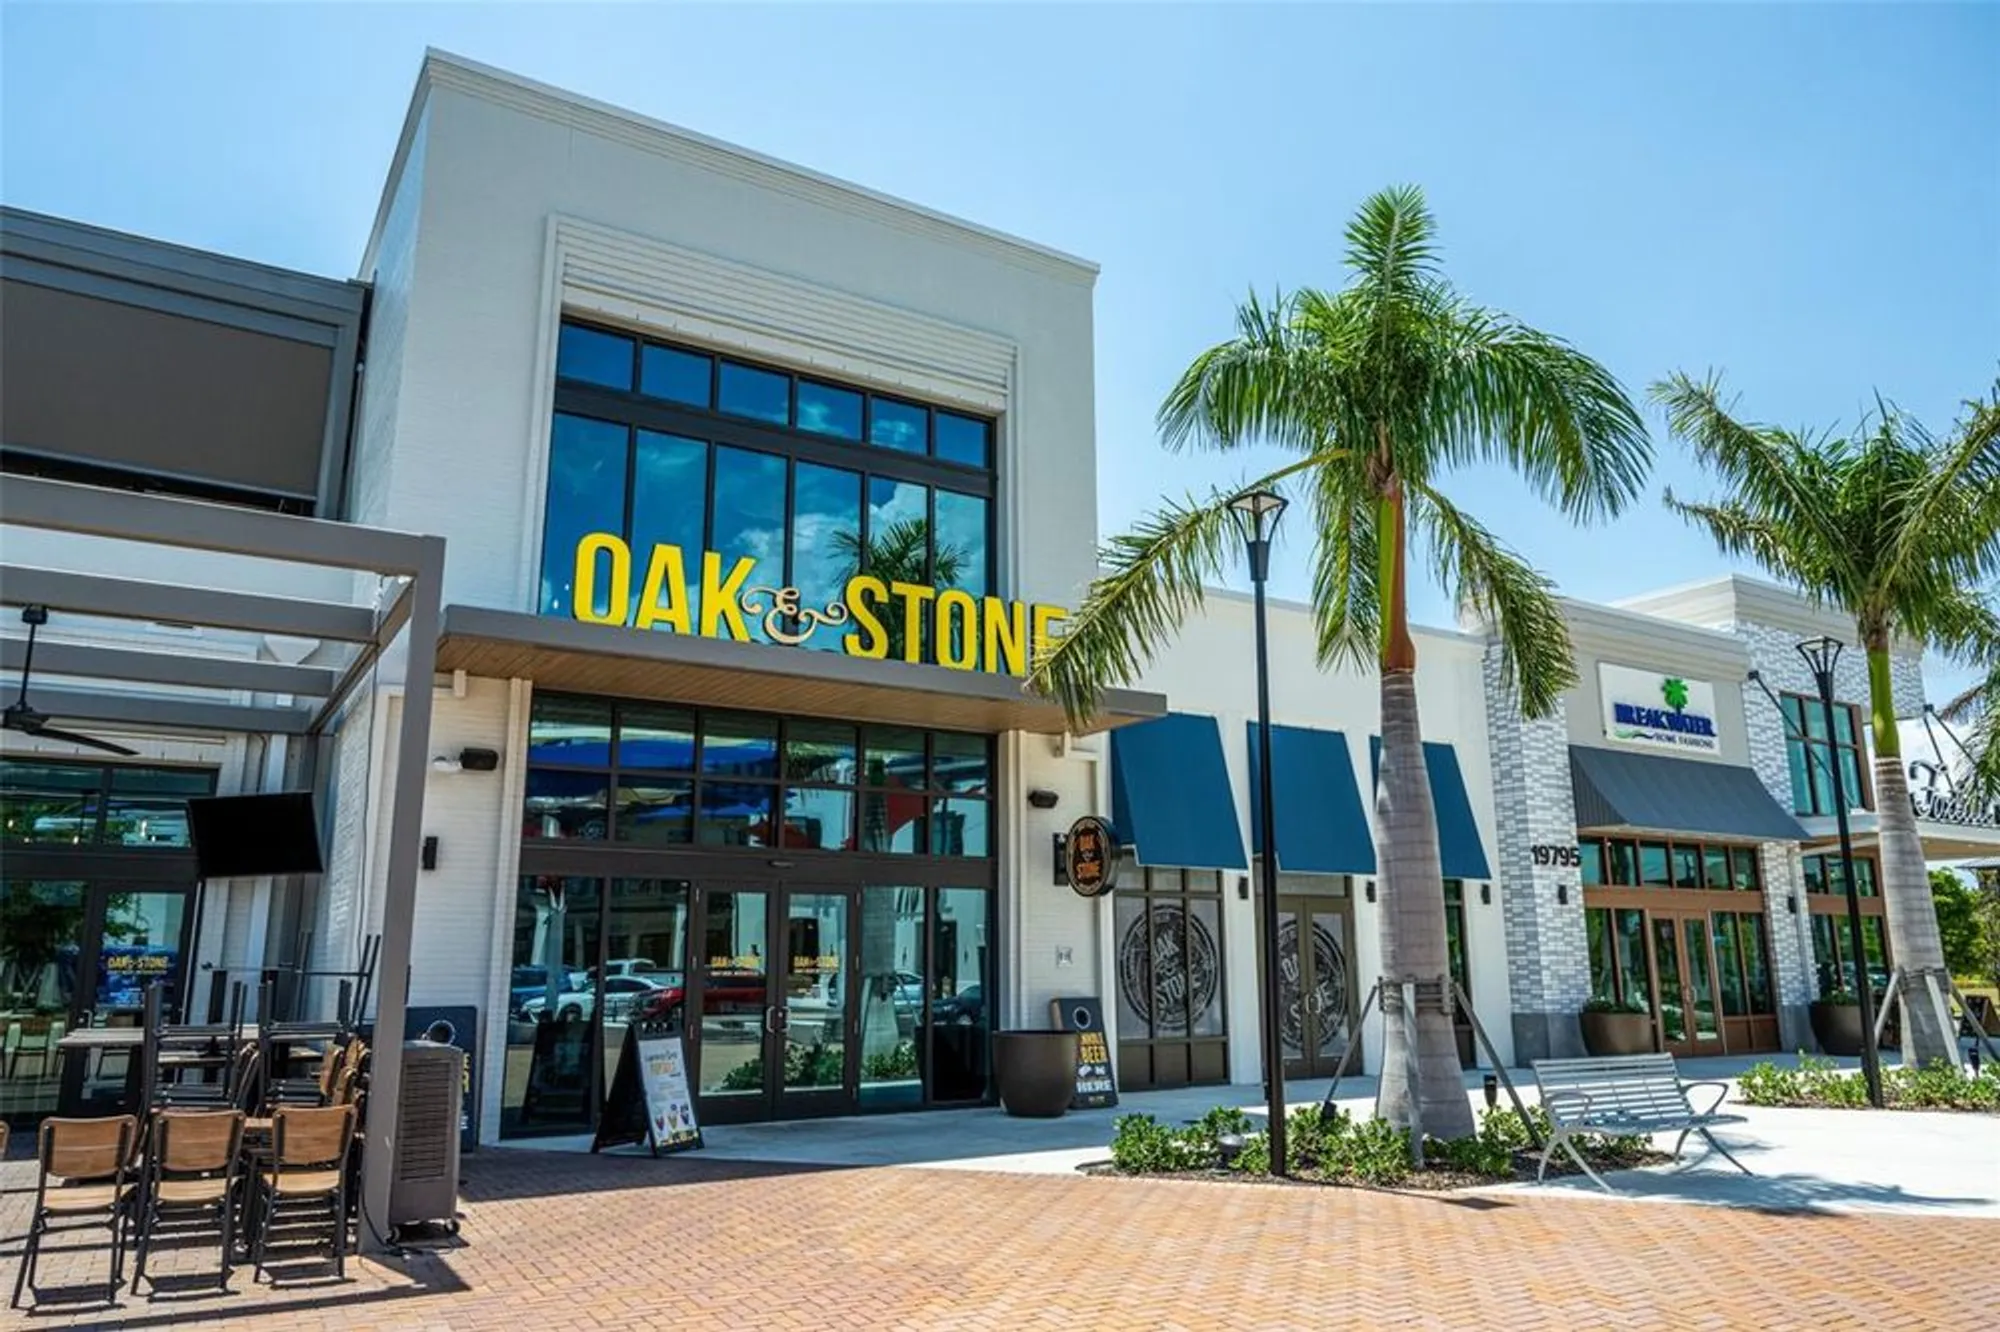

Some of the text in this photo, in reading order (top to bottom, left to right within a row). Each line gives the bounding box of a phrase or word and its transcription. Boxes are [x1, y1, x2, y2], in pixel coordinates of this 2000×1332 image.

[574, 532, 757, 642] OAK
[1614, 702, 1717, 737] BREAKWATER
[1530, 844, 1582, 867] 19795
